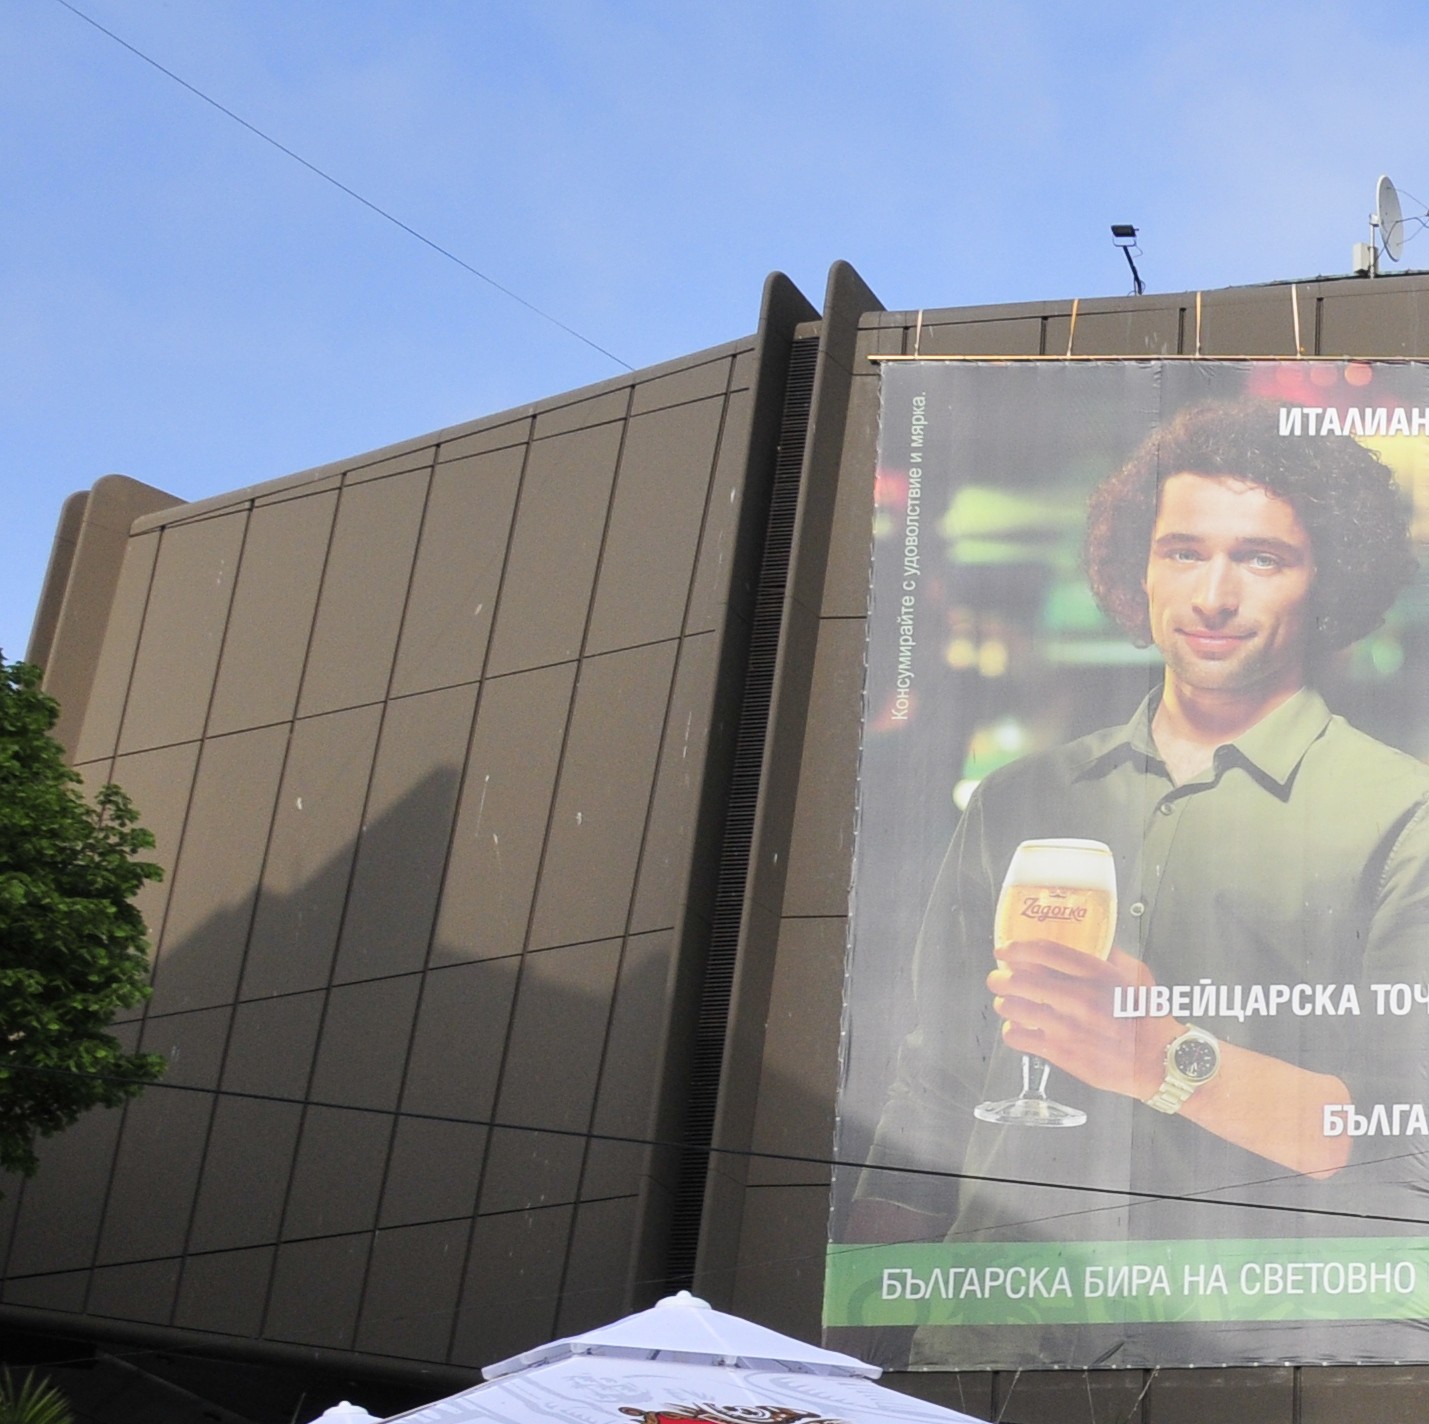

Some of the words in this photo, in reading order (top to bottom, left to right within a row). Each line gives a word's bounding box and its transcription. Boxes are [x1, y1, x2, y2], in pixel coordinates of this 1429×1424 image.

[910, 391, 927, 448] мярка.
[909, 452, 922, 463] и
[904, 467, 922, 576] удоволствие
[903, 580, 915, 591] с
[891, 595, 915, 720] Консумирайте
[1020, 894, 1087, 922] Zagorka
[1113, 980, 1360, 1024] ШВЕЙЦАРСКА
[881, 1265, 1073, 1300] БЪЛГАРСКА
[1083, 1264, 1171, 1299] БИРА
[1181, 1263, 1228, 1297] НА
[1239, 1260, 1417, 1296] СВЕТОВНО
